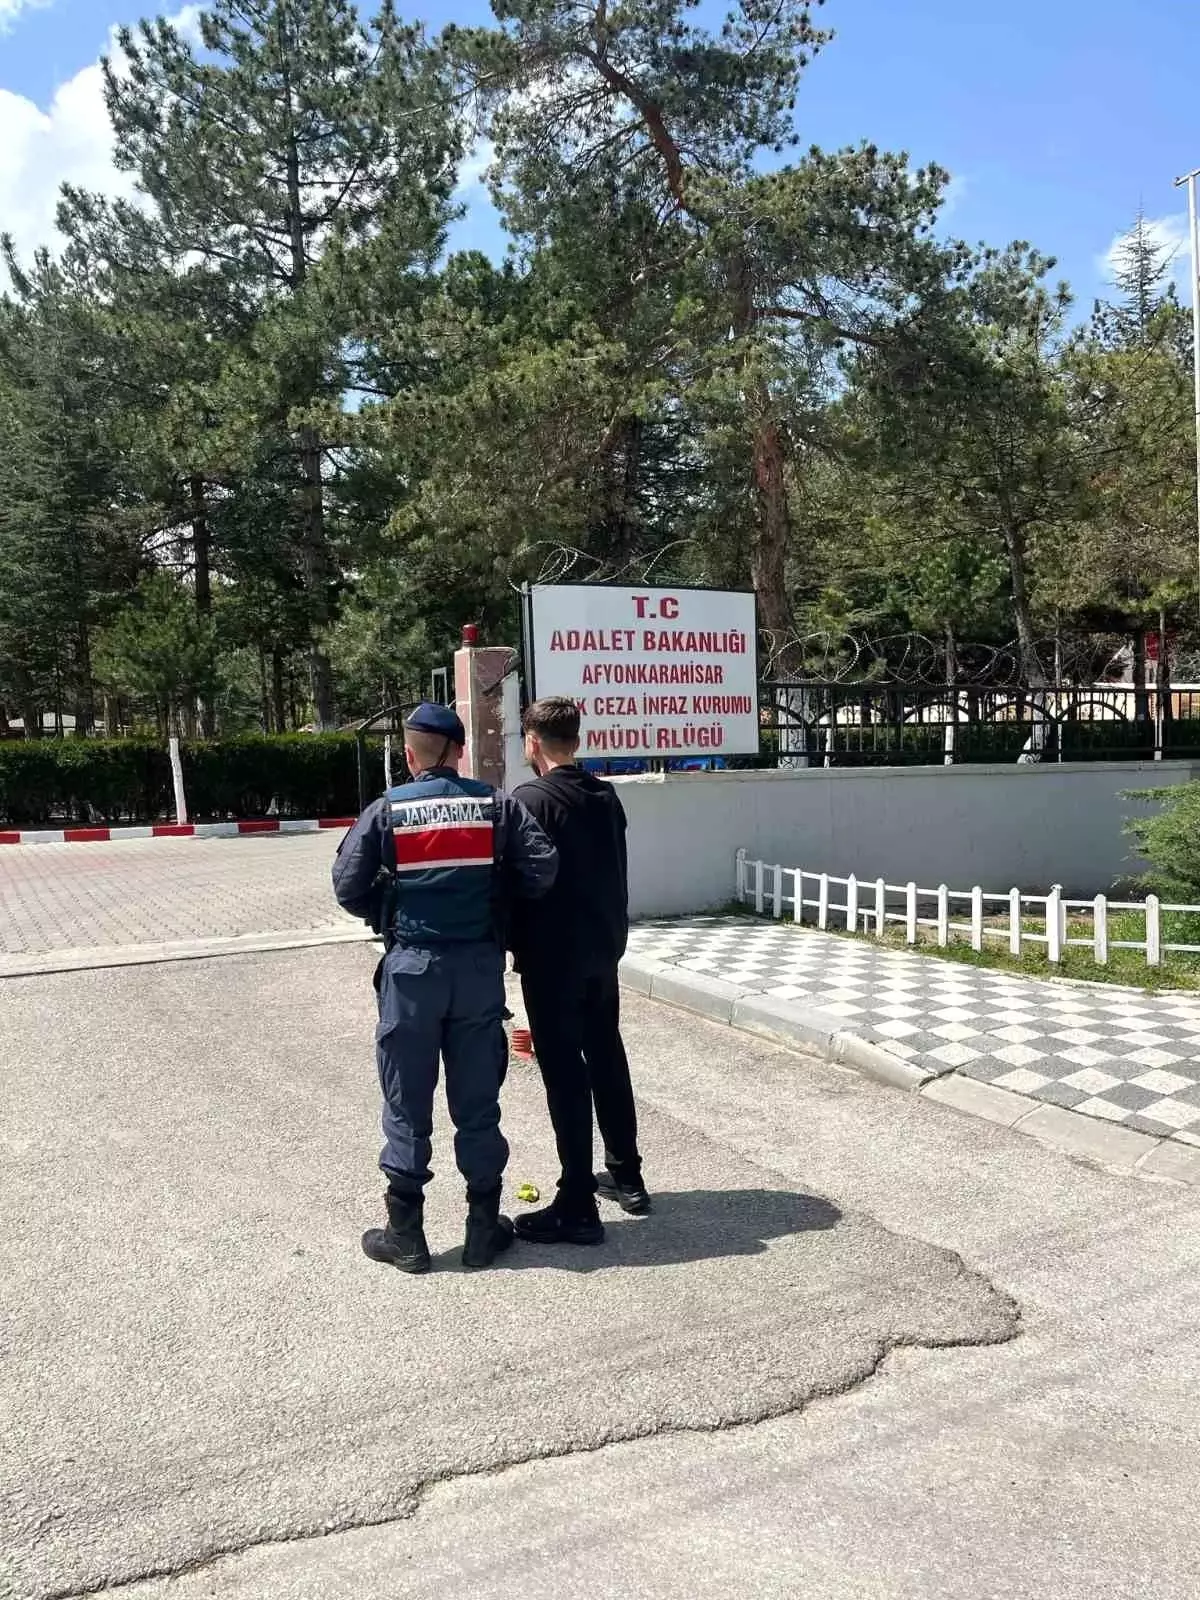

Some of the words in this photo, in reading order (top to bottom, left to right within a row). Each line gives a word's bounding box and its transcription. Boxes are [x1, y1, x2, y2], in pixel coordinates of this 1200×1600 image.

[632, 595, 679, 620] T.C
[549, 629, 636, 652] ADALET
[643, 629, 746, 654] BAKANLIĞI
[582, 660, 723, 685] AFYONKARAHİSAR
[594, 696, 638, 716] CEZA
[643, 692, 688, 715] İNFAZ
[692, 695, 752, 715] KURUMU
[401, 802, 484, 826] JANDARMA
